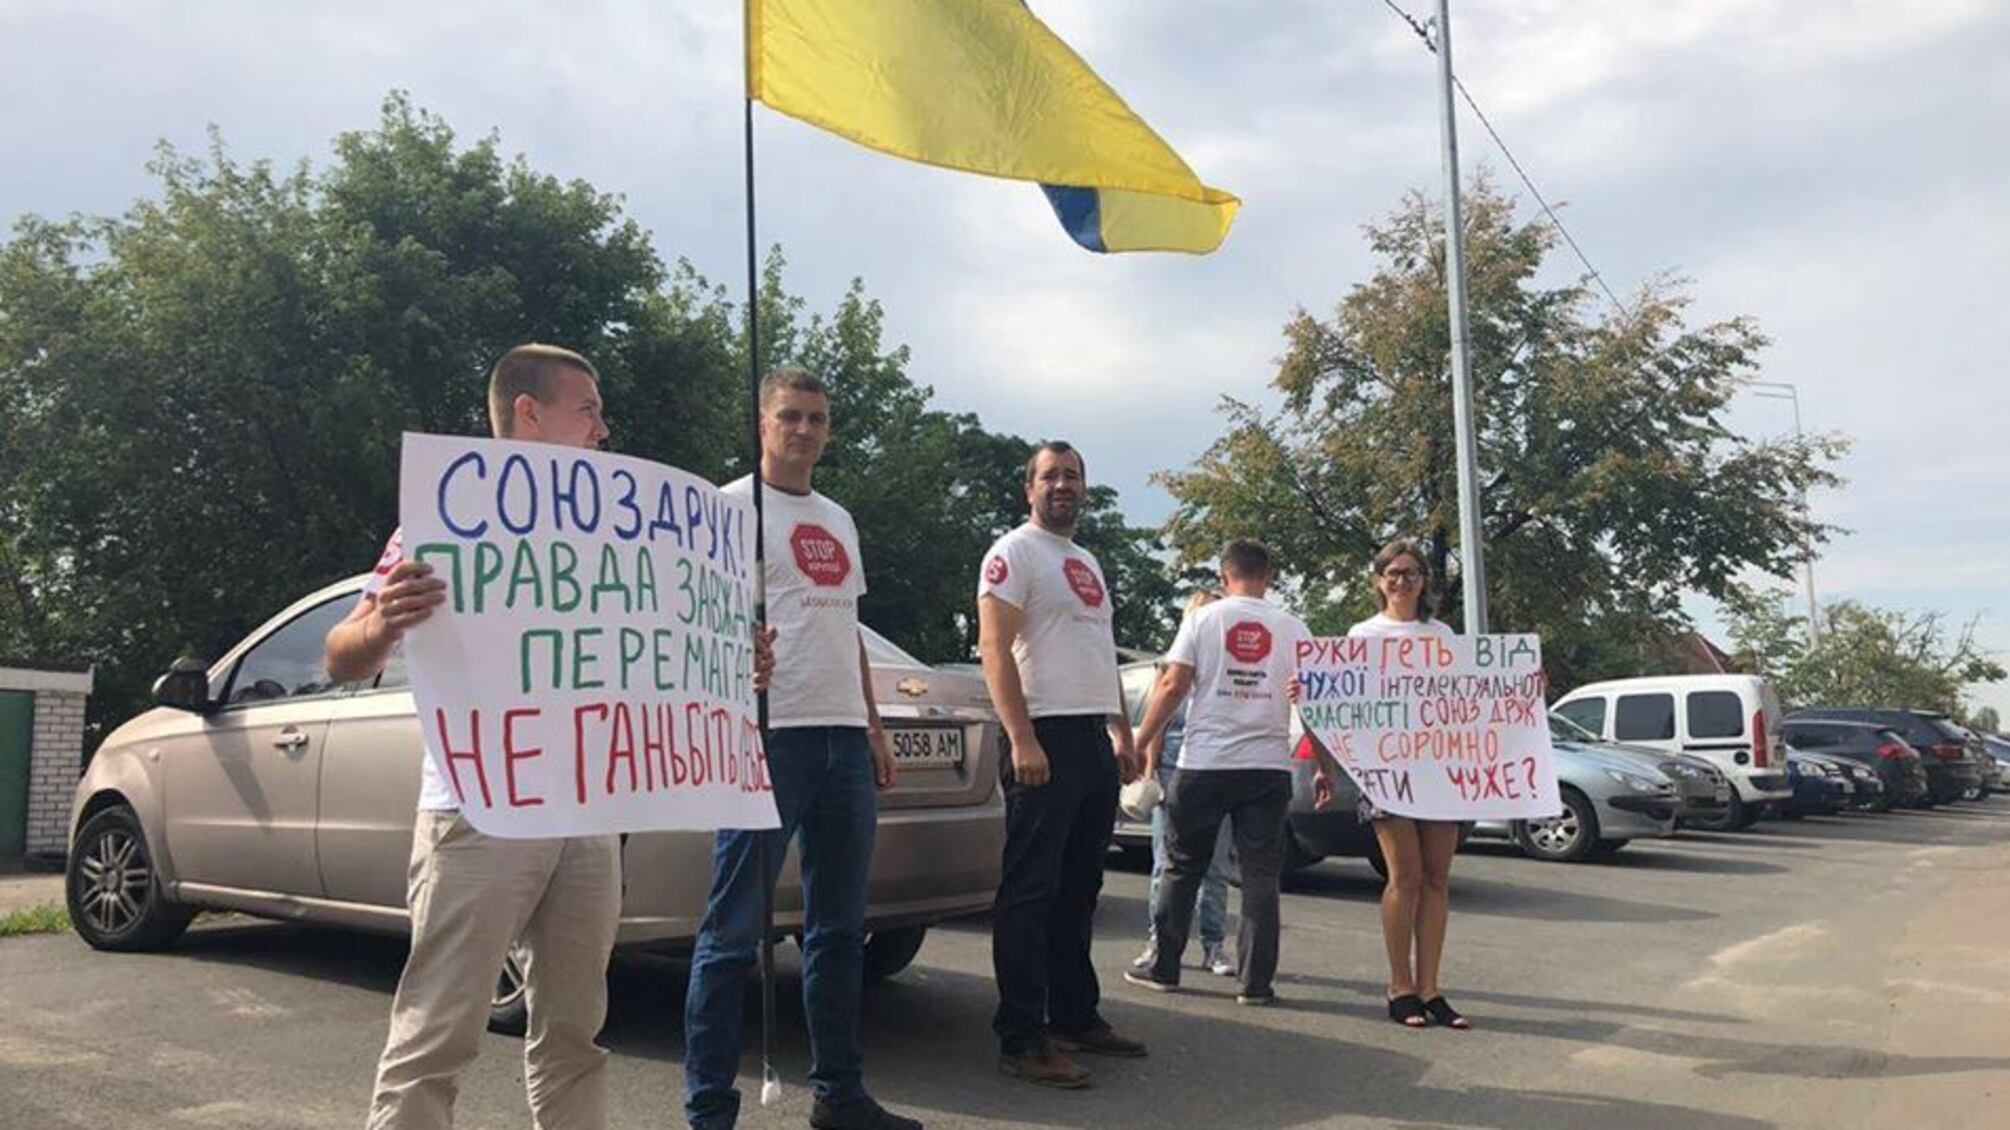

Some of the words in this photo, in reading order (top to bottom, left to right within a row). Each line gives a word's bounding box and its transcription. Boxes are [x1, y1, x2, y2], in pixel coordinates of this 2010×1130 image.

[437, 451, 747, 579] СОЮЗДРУК!
[414, 539, 658, 615] ПРАВДА
[1296, 638, 1369, 668] РУКИ
[1420, 697, 1481, 728] СОЮЗ
[436, 706, 544, 809] НЕ
[893, 732, 933, 758] 5058
[1378, 729, 1499, 765] СОРОМНО
[1446, 756, 1538, 802] ЧУЖЕ?
